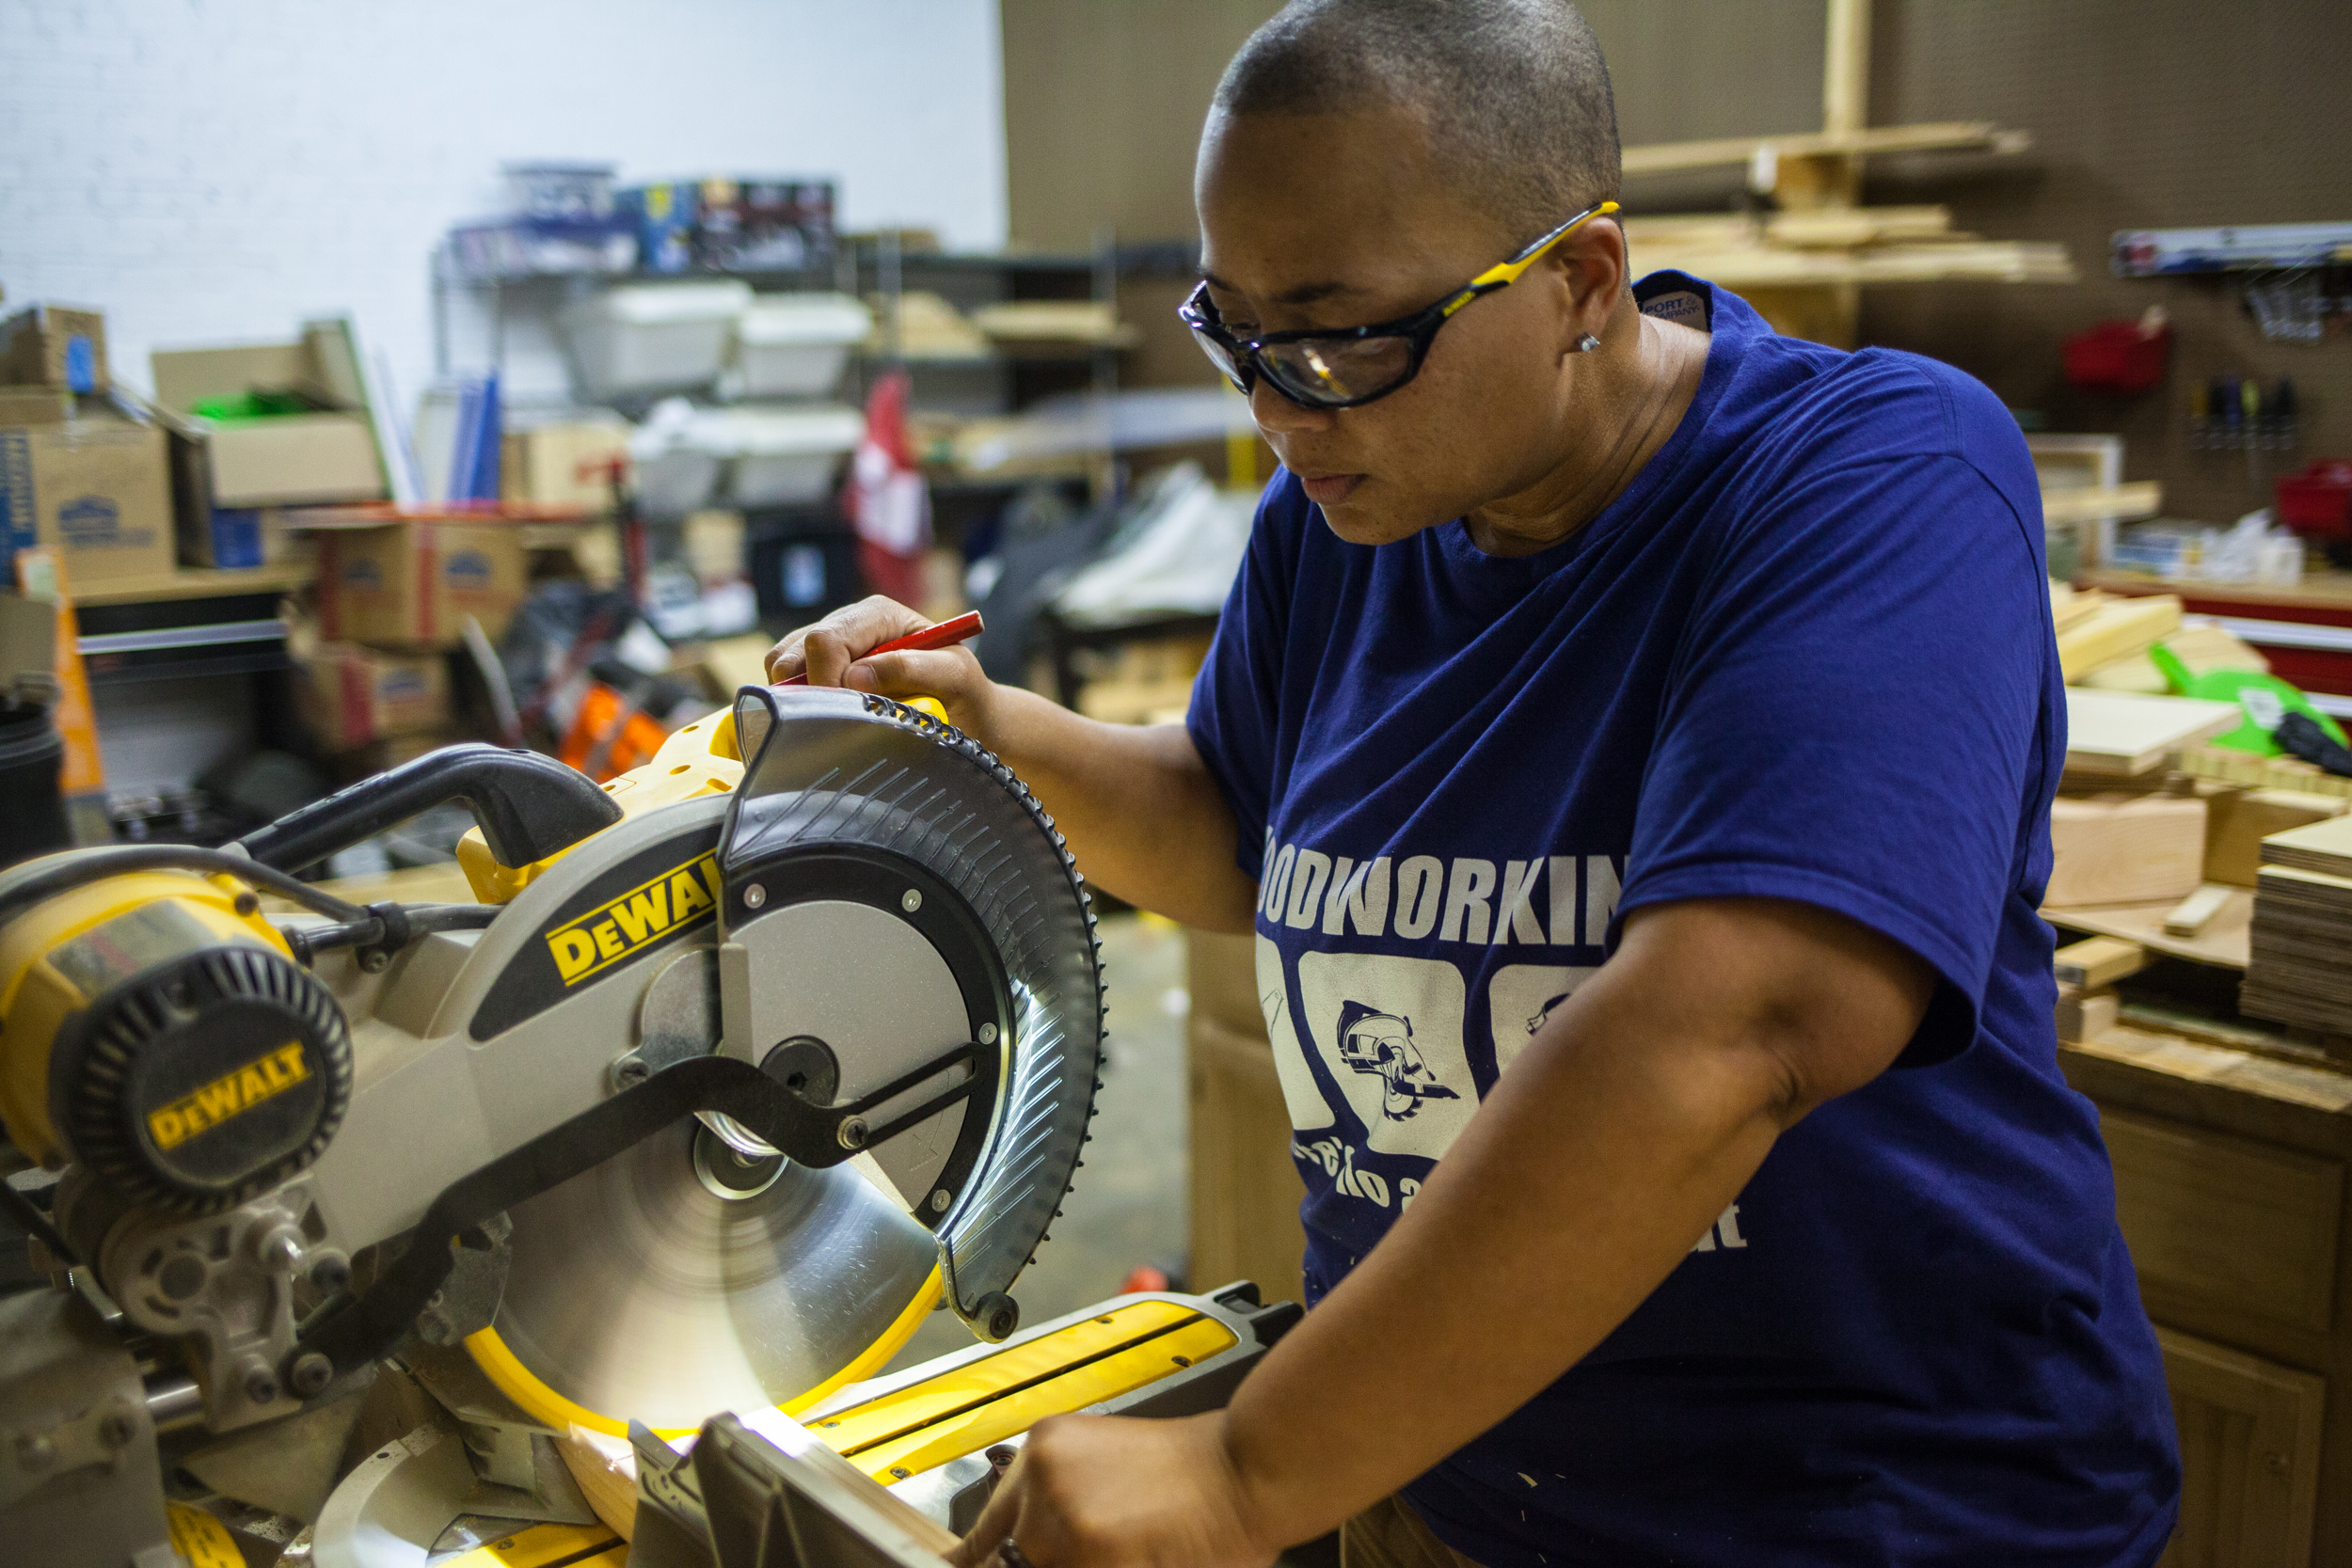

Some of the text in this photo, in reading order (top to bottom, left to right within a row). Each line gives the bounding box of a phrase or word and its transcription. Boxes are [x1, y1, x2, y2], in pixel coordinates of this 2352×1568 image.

[1645, 294, 1697, 313] PORT &
[548, 856, 723, 980] DEWAL
[1258, 825, 1630, 945] OODWORKIN
